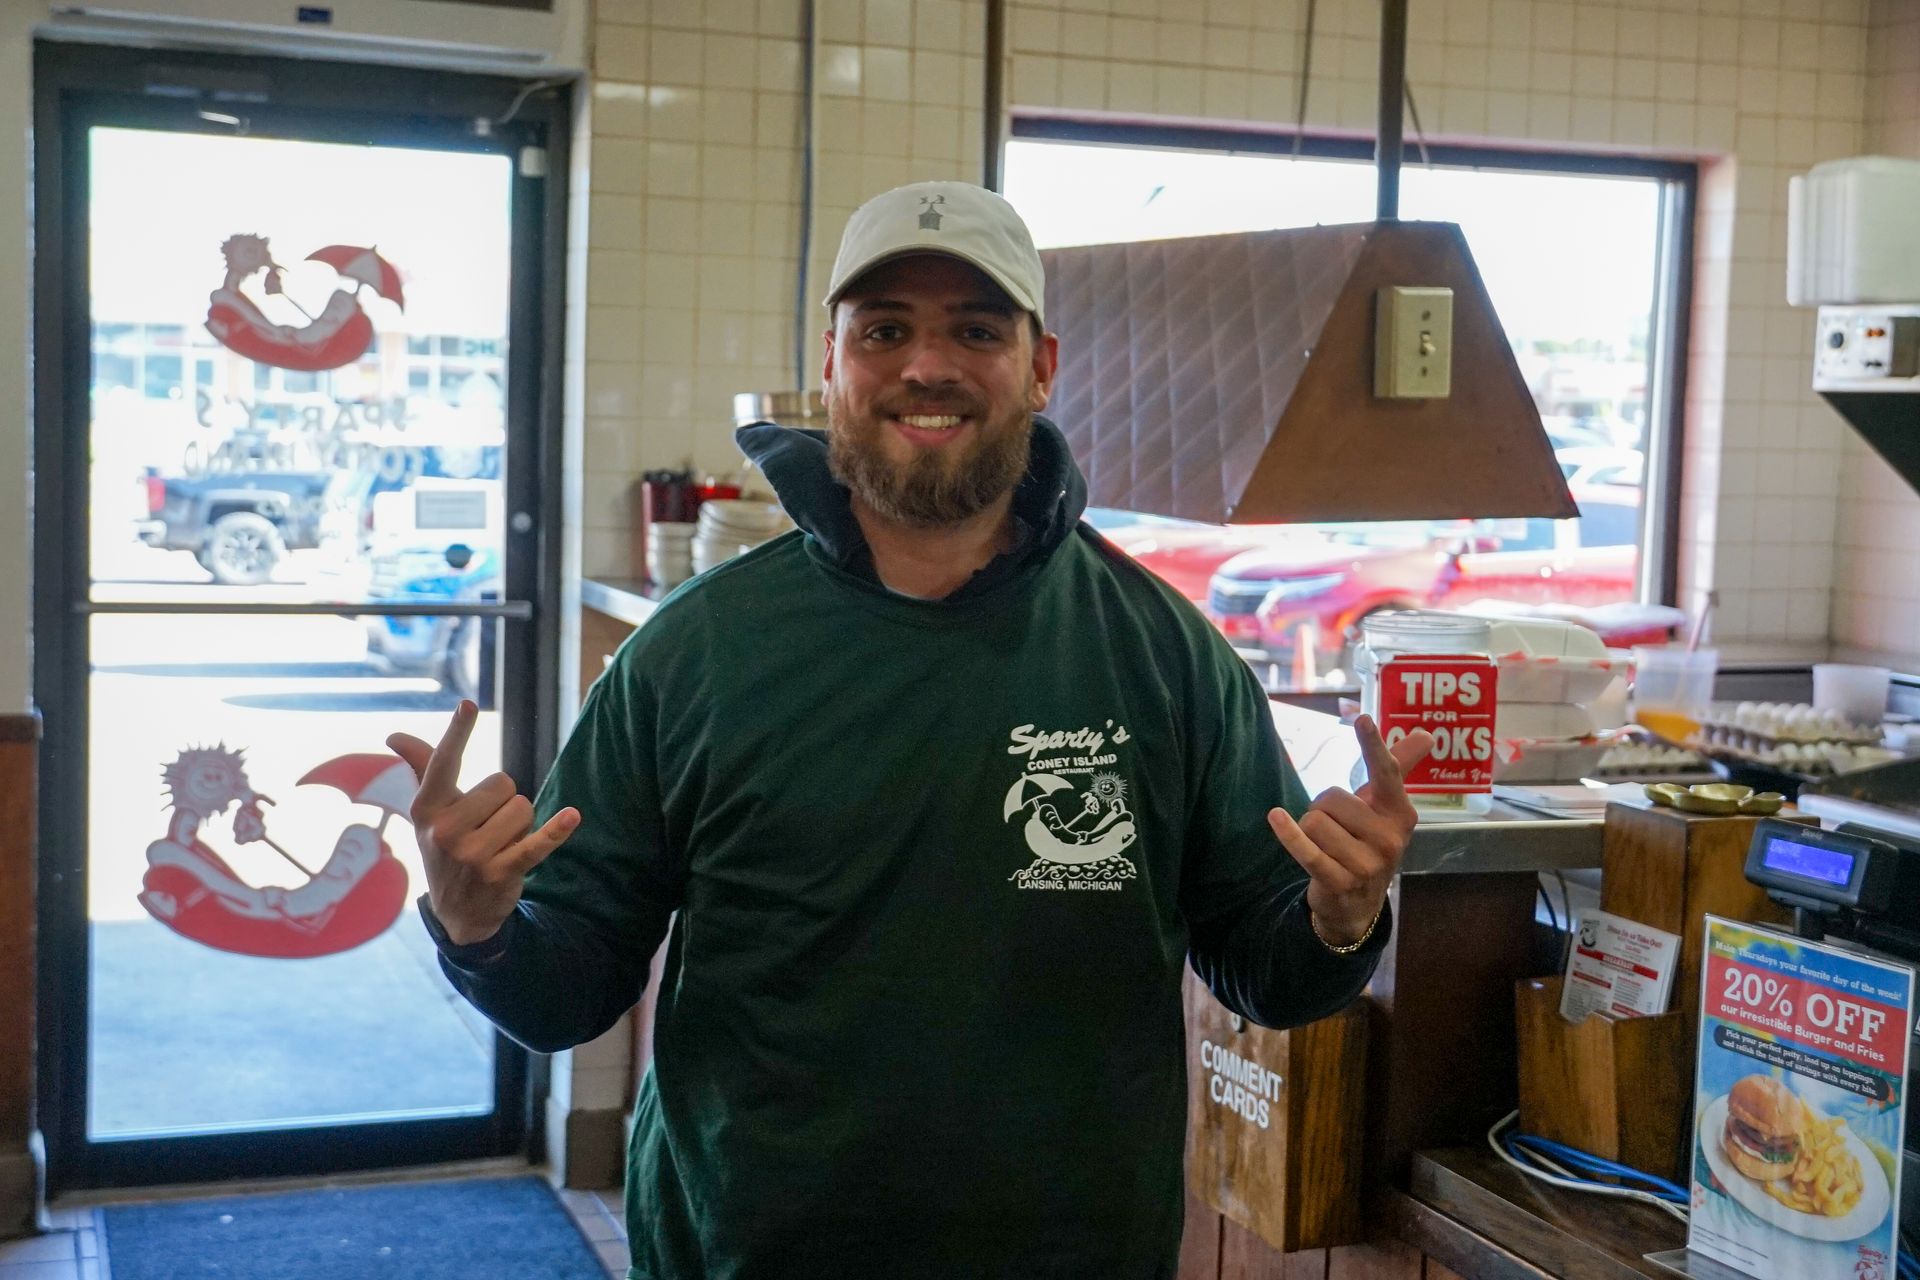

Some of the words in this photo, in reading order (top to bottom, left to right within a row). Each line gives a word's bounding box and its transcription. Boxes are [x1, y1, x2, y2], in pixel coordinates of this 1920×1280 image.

[1400, 672, 1482, 706] TIPS
[1422, 710, 1458, 722] FOR
[1007, 719, 1131, 760] Sparty's
[1386, 726, 1492, 761] COKS
[1027, 757, 1071, 771] CONEY
[1073, 754, 1118, 767] ISLAND
[1053, 767, 1095, 775] RESTAURANT
[1429, 768, 1467, 780] Thank
[1018, 879, 1066, 891] LANSING,
[1068, 880, 1122, 891] MICHIGAN
[1715, 940, 1735, 954] Make
[1738, 949, 1778, 968] Thursdays
[1779, 960, 1798, 973] your
[1800, 964, 1831, 982] favorite
[1833, 974, 1848, 988] day
[1850, 979, 1860, 990] of
[1861, 982, 1875, 995] the
[1723, 968, 1793, 1017] 20%
[1806, 993, 1886, 1042] OFF
[1720, 1003, 1738, 1016] our
[1740, 1006, 1793, 1034] irresistible
[1795, 1024, 1832, 1045] Burger
[1834, 1038, 1855, 1053] and
[1857, 1045, 1885, 1063] Fries
[1725, 1029, 1740, 1039] Pick
[1741, 1035, 1757, 1046] your
[1758, 1038, 1781, 1054] perfect
[1804, 1054, 1819, 1066] load
[1821, 1061, 1830, 1071] up
[1831, 1065, 1841, 1074] on
[1201, 1040, 1282, 1104] COMMENT
[1722, 1039, 1735, 1049] and
[1736, 1043, 1754, 1056] relish
[1756, 1049, 1766, 1060] the
[1768, 1053, 1784, 1065] taste
[1785, 1058, 1794, 1068] of
[1823, 1070, 1838, 1082] with
[1840, 1076, 1860, 1091] every
[1210, 1074, 1270, 1129] CARDS
